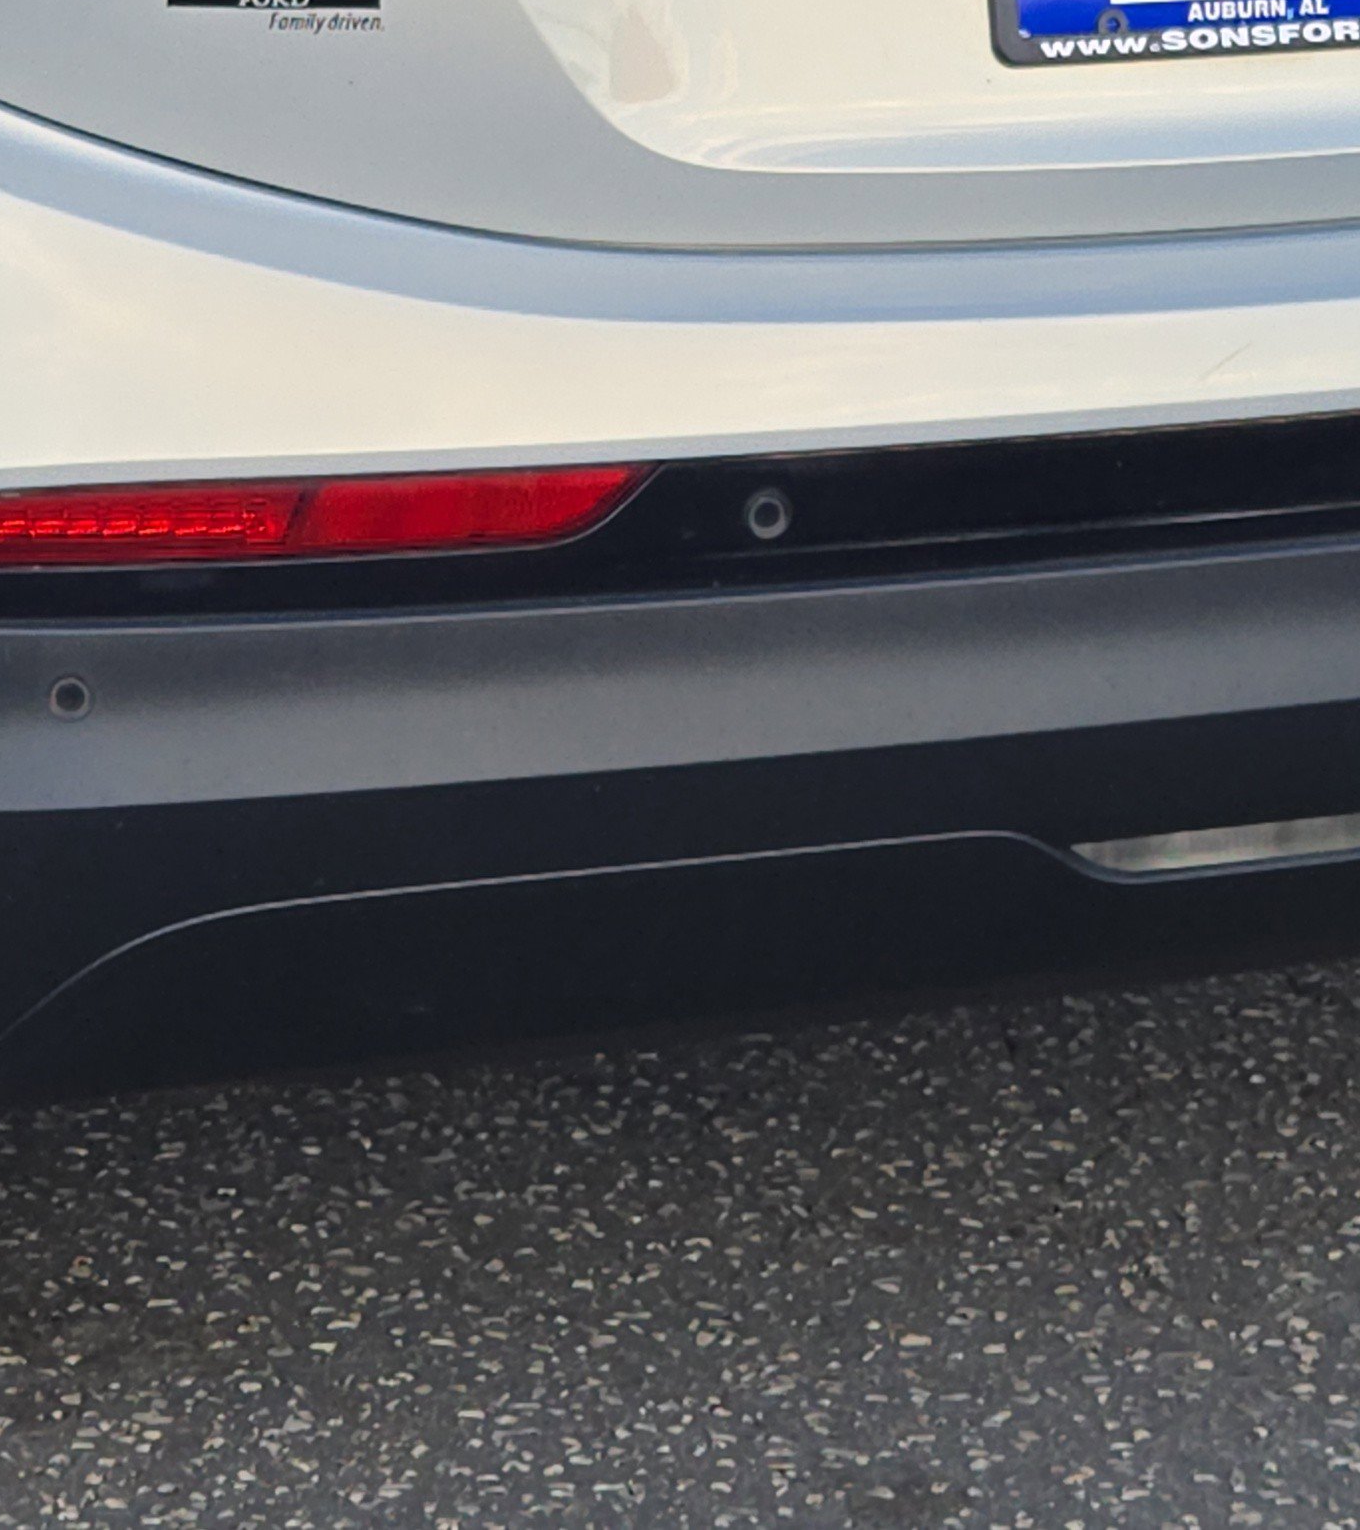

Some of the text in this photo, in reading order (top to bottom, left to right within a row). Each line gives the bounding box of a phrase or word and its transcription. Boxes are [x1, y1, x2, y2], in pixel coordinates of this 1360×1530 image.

[1187, 0, 1293, 21] AUBURN,
[269, 12, 385, 35] Family driven.
